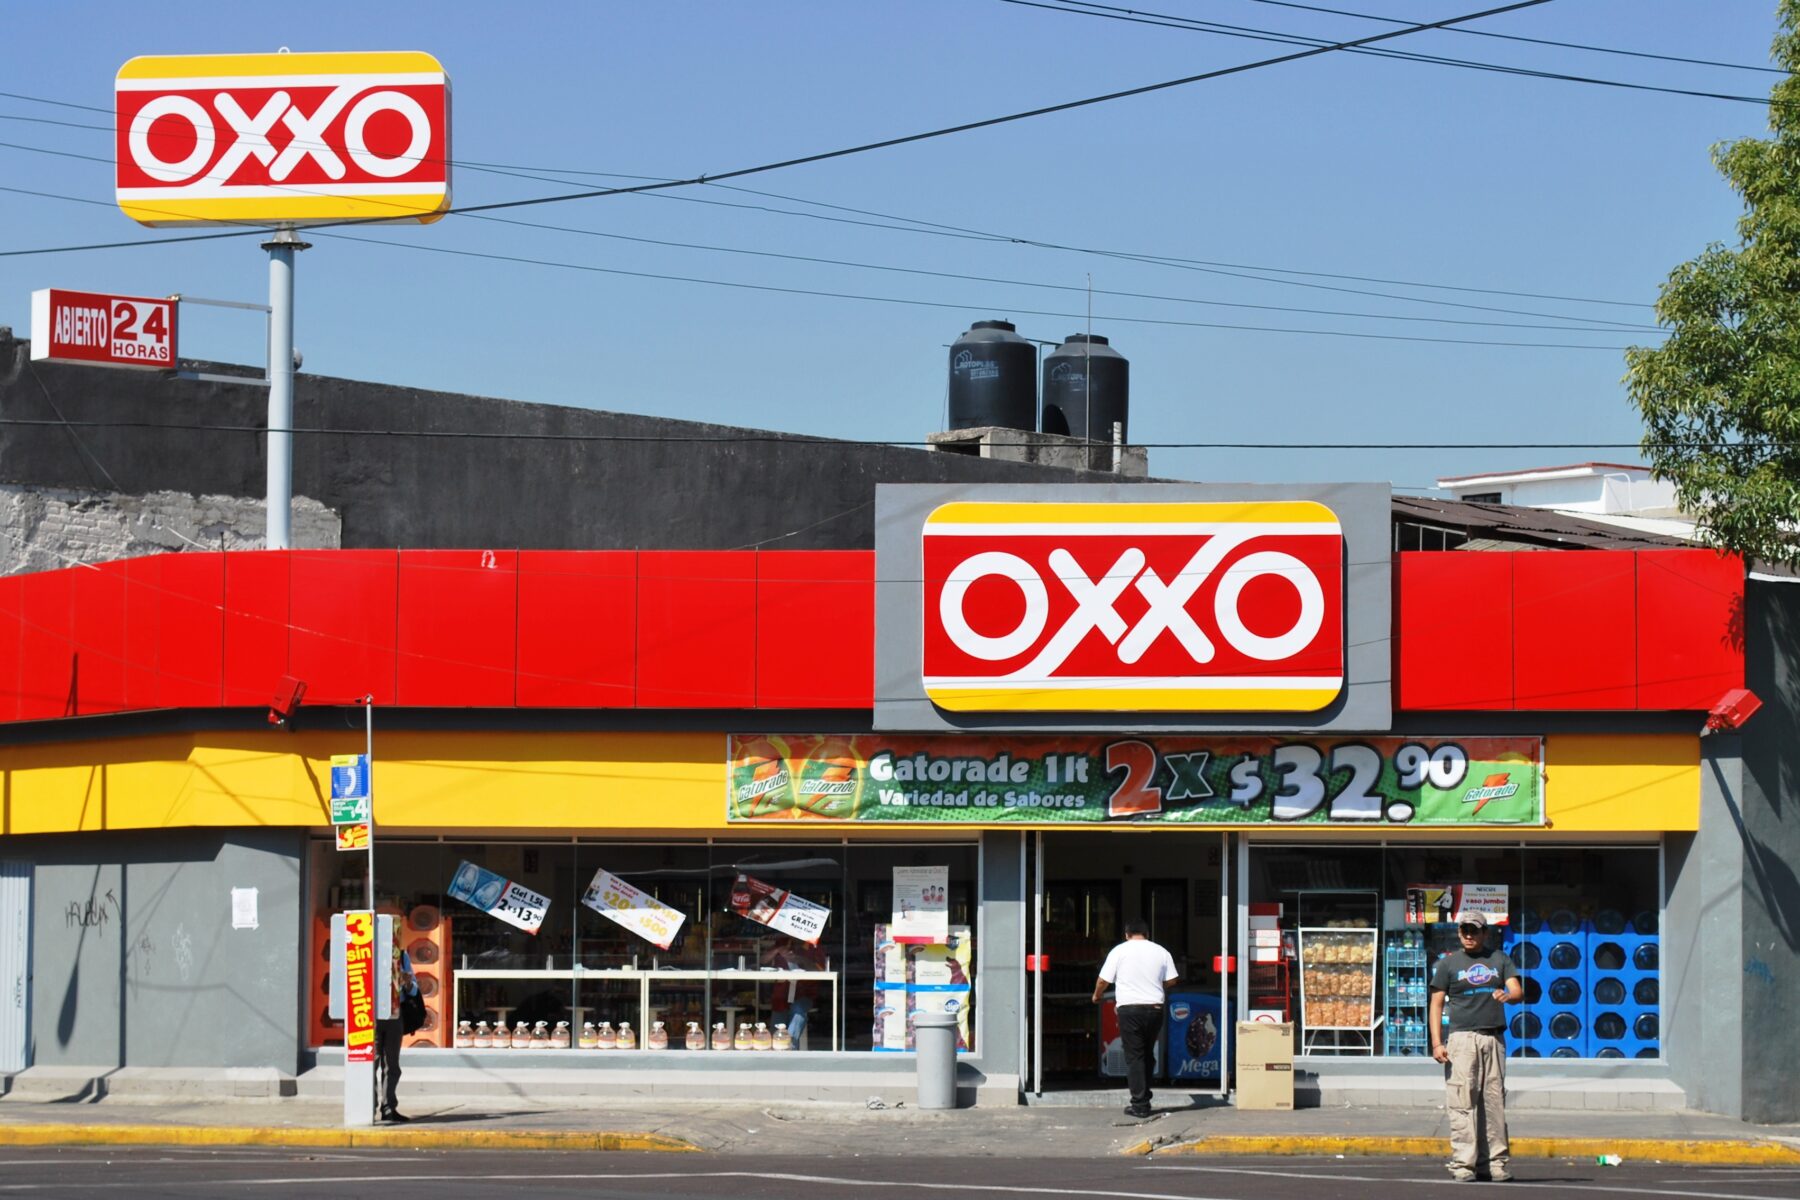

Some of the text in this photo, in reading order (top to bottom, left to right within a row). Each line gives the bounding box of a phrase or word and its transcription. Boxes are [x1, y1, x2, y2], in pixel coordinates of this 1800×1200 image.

[129, 88, 431, 184] OXXO
[54, 305, 108, 348] ABIERTO
[113, 302, 168, 344] 24
[113, 343, 168, 359] HORAS
[940, 536, 1325, 676] OXXO
[869, 754, 1030, 784] Gatorade
[739, 771, 788, 802] Gatorade
[801, 780, 856, 794] Gatorade
[878, 789, 1086, 808] Variedad de Sabores
[1463, 784, 1519, 801] Gatorade
[346, 913, 374, 946] 3
[791, 914, 818, 930] GRATIS
[346, 945, 372, 961] sin
[1176, 1058, 1219, 1077] Mega
